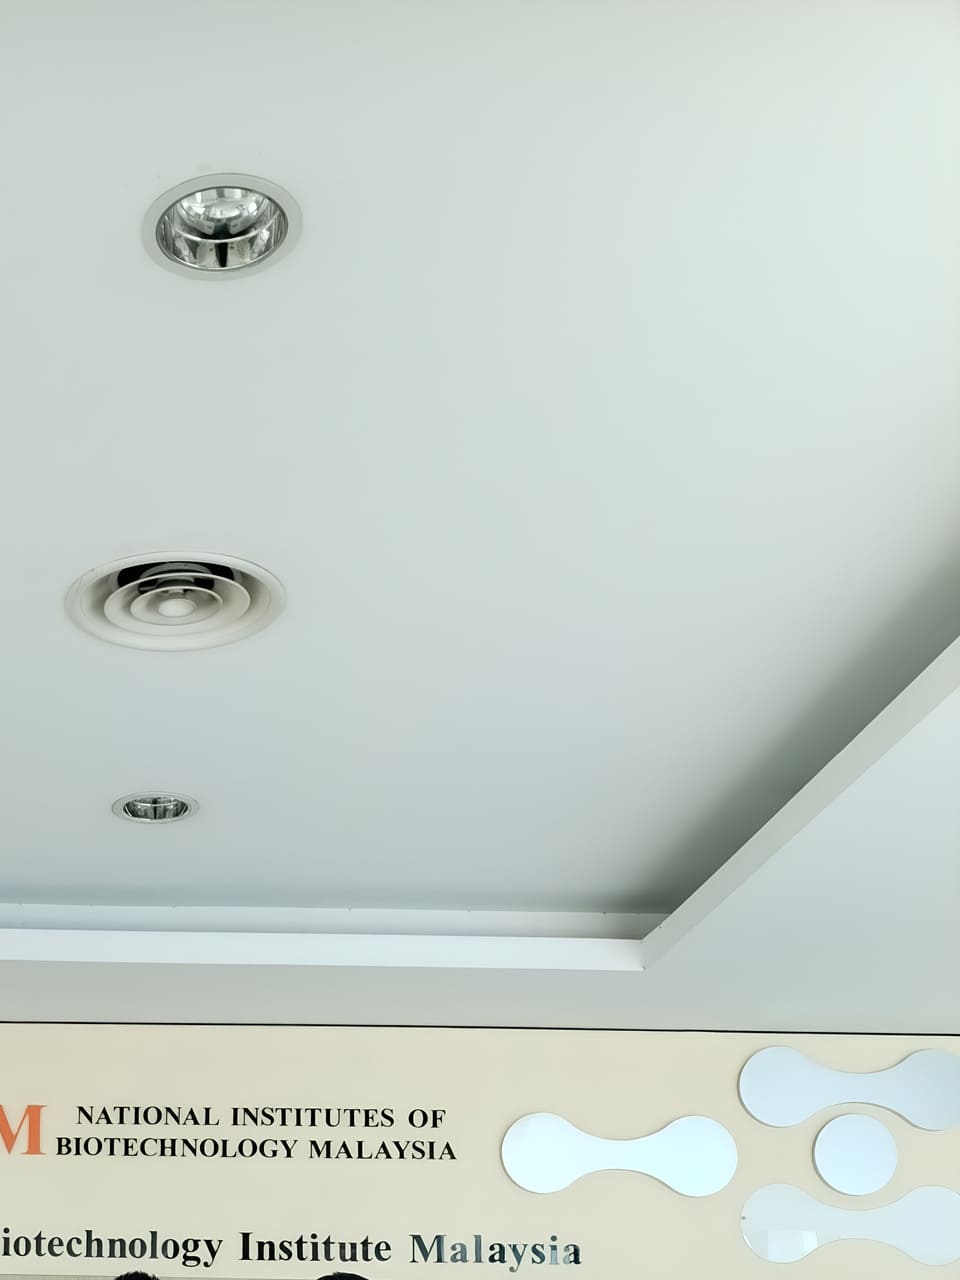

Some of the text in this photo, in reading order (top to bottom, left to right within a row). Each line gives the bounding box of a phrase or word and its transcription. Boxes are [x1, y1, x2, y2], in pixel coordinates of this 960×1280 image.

[77, 1105, 447, 1129] NATIONAL INSTITUTES OF
[55, 1136, 457, 1161] BIOTECHNOLOGY MALAYSIA
[238, 1231, 392, 1263] Institute
[408, 1234, 582, 1273] Malaysia
